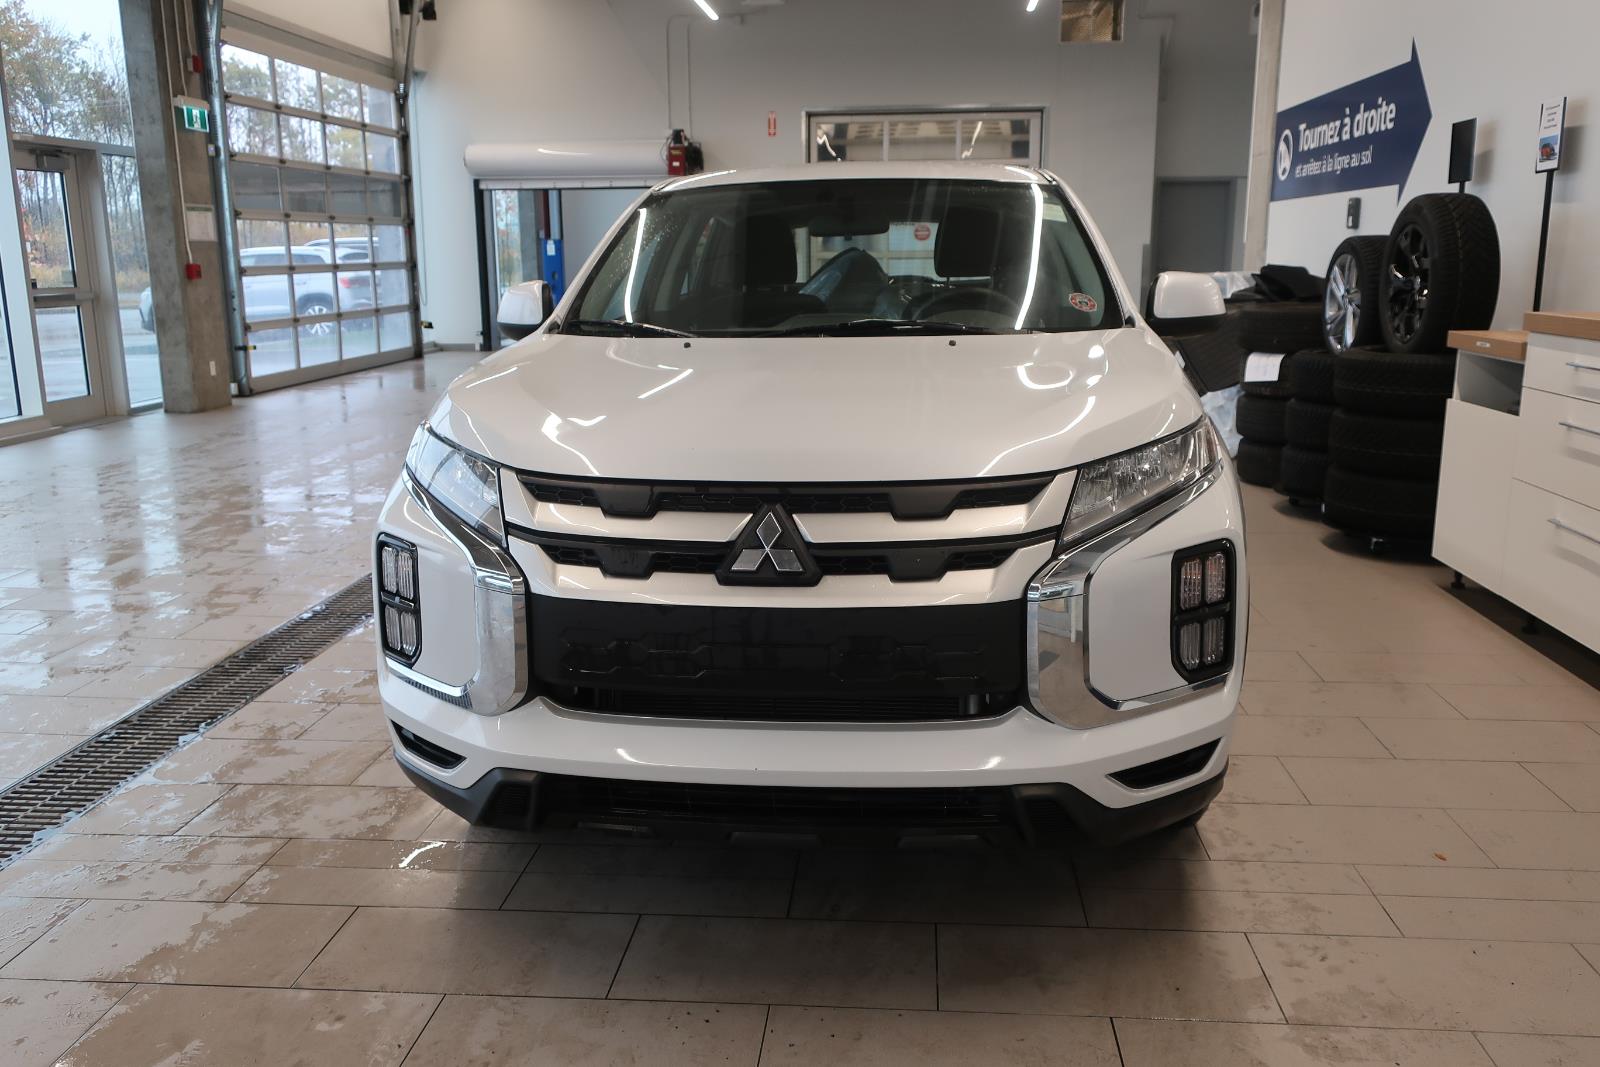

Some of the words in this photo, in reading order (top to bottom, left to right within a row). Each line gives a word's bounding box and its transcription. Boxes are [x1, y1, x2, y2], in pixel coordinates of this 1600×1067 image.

[1298, 120, 1341, 152] Tournez
[1342, 107, 1351, 141] à
[1353, 97, 1396, 138] droite
[1295, 164, 1302, 178] et
[1322, 154, 1328, 173] à
[1327, 154, 1334, 172] la
[1334, 152, 1350, 175] ligne
[1350, 152, 1360, 168] au
[1360, 144, 1373, 166] sol
